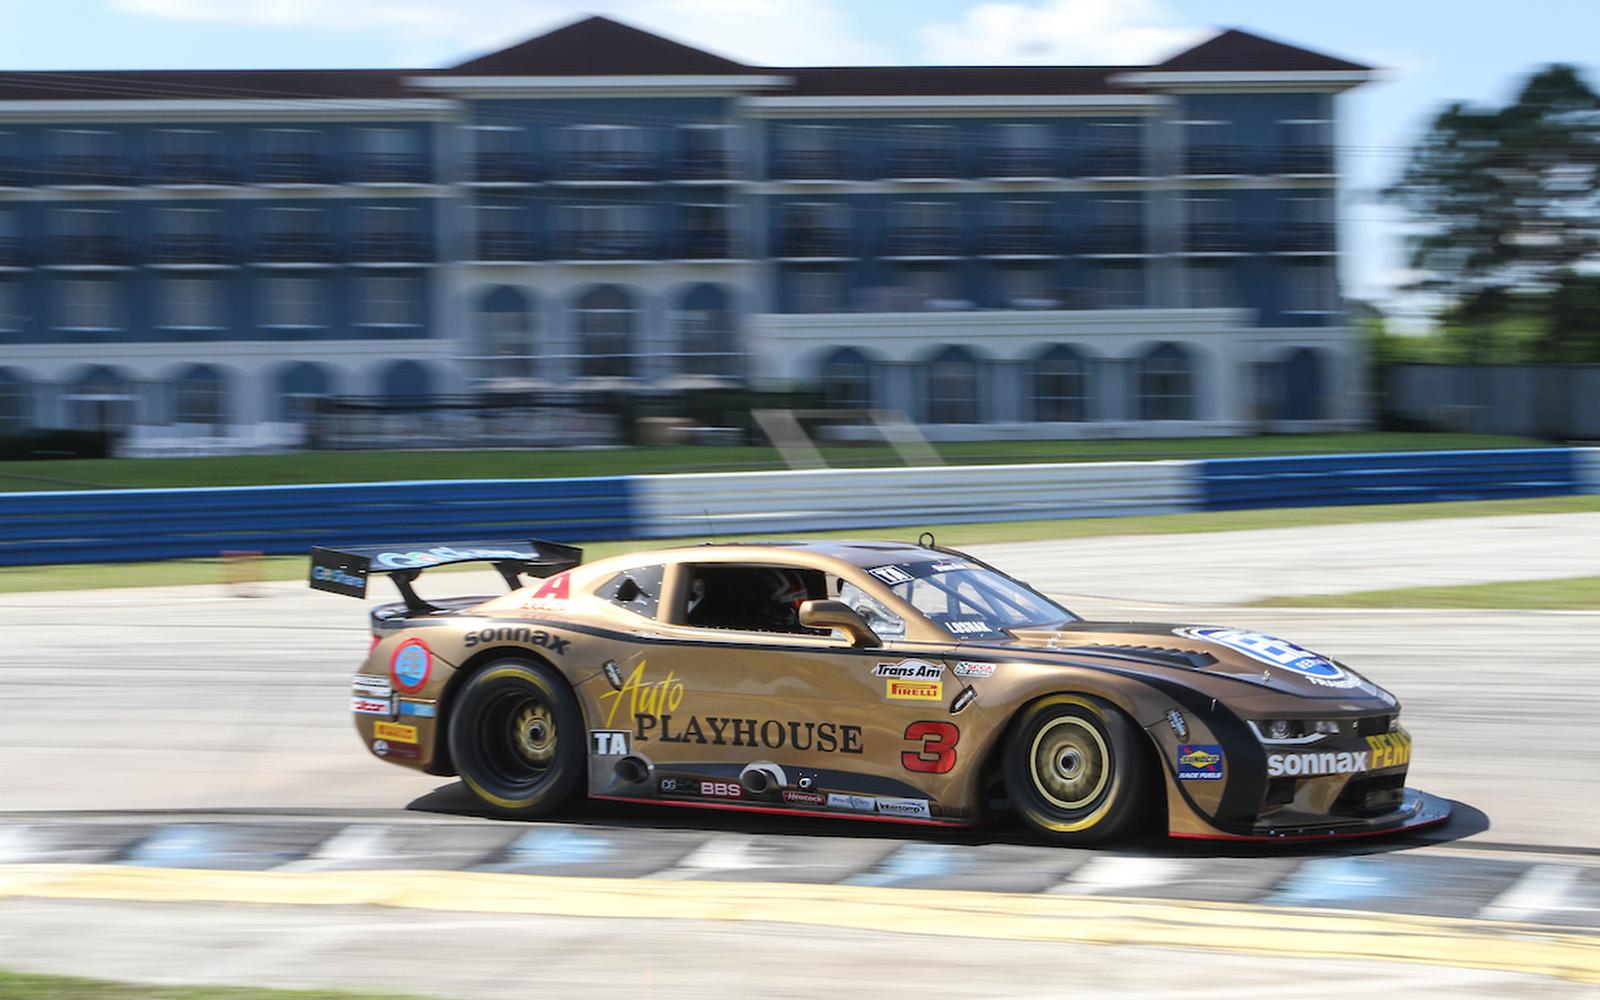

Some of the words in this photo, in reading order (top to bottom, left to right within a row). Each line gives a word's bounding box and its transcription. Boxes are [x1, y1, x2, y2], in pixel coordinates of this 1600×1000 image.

[464, 627, 571, 656] sonnax
[877, 664, 915, 677] Trans
[600, 660, 683, 728] Auto
[891, 683, 938, 697] PIRELLI
[594, 732, 628, 755] TA
[634, 713, 864, 754] PLAYHOUSE
[901, 720, 960, 774] 3
[1266, 751, 1368, 776] sonnax
[700, 781, 741, 797] BBS
